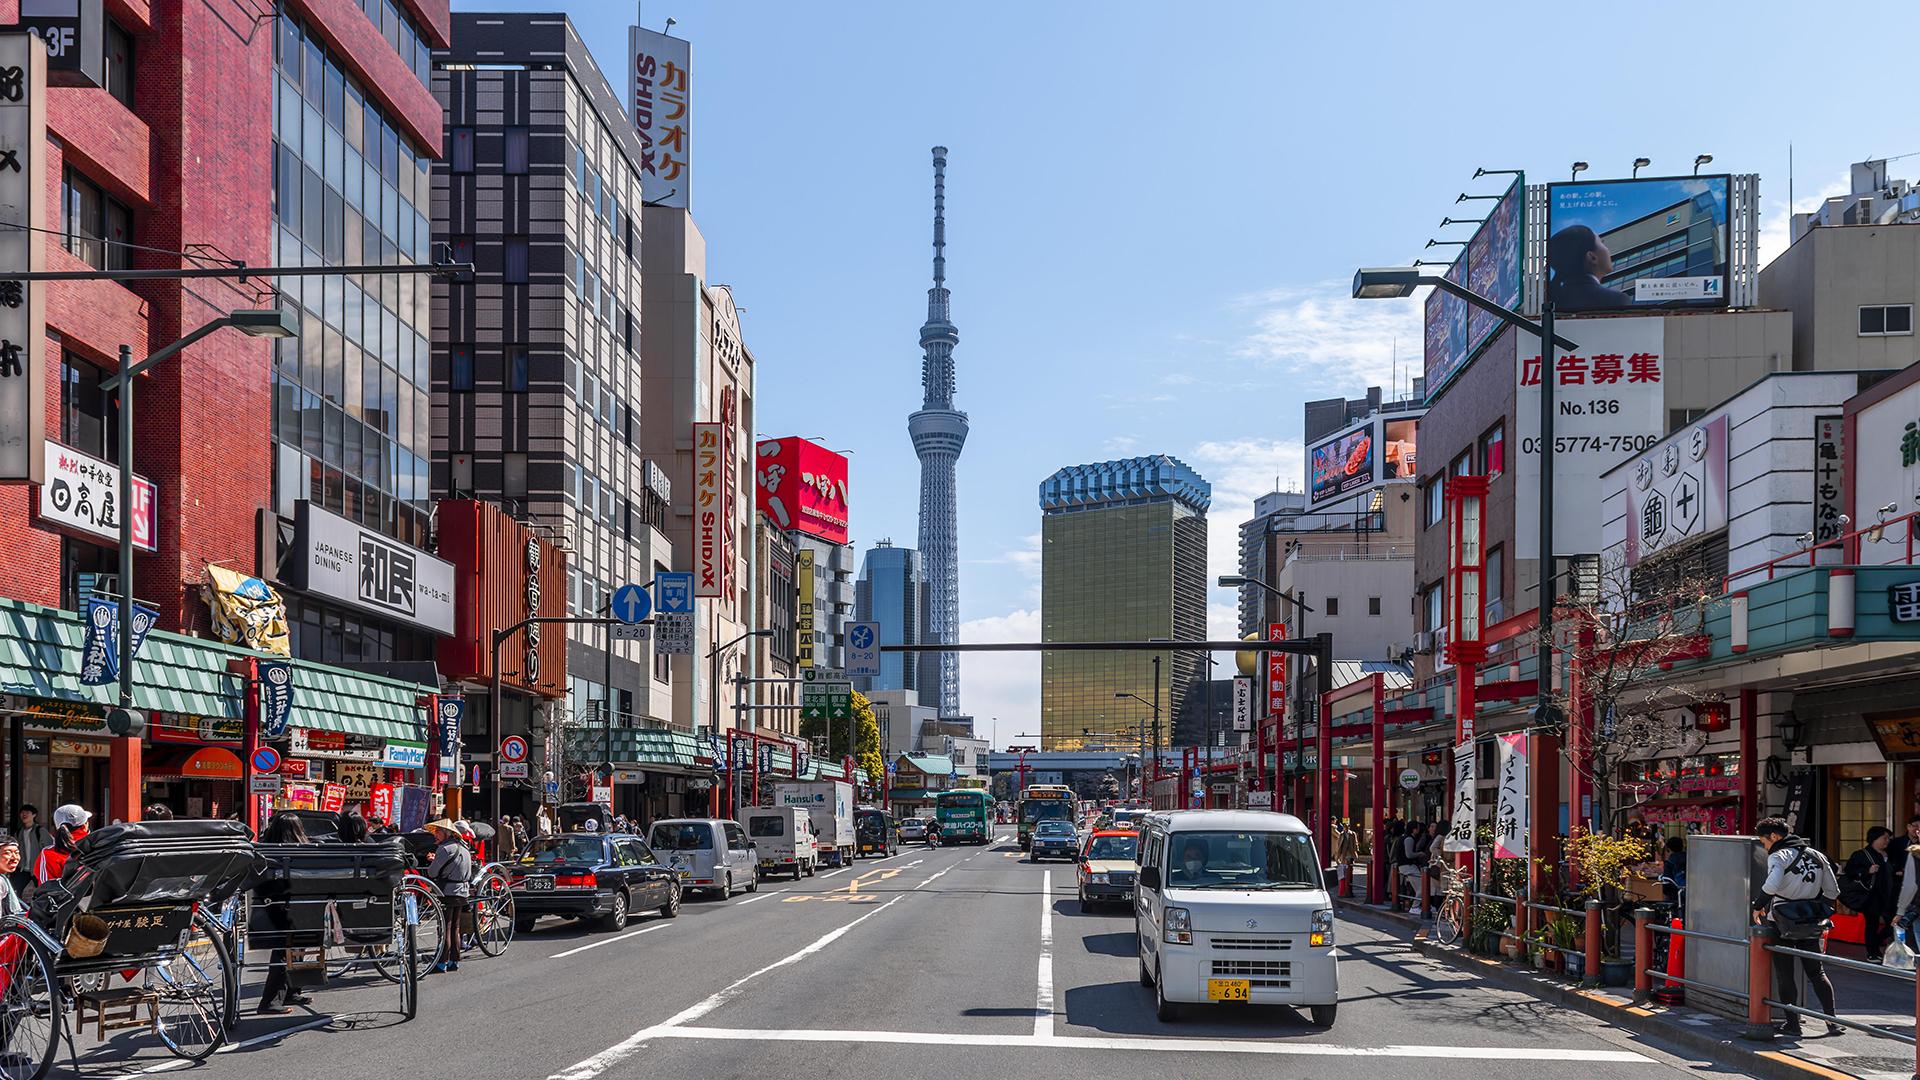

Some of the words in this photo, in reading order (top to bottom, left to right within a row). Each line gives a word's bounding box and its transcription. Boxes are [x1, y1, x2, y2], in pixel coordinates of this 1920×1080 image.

[637, 53, 656, 176] SHIDAX
[659, 61, 687, 180] カラオケ
[1520, 353, 1662, 386] 広告募集
[1560, 400, 1620, 415] No.136
[1522, 435, 1657, 454] 035774-7506
[58, 453, 113, 487] 熱烈中華食堂
[699, 430, 717, 507] カラオケ
[50, 478, 120, 528] 日高屋
[1819, 442, 1841, 540] 亀十もなか
[315, 542, 353, 564] JAPANESE
[315, 555, 341, 572] DINING
[702, 511, 715, 589] SHIDAX
[362, 542, 413, 610] 和民
[419, 584, 450, 603] wa-ta-mi
[389, 746, 425, 765] FamilyMart
[1497, 754, 1518, 840] さくら餅
